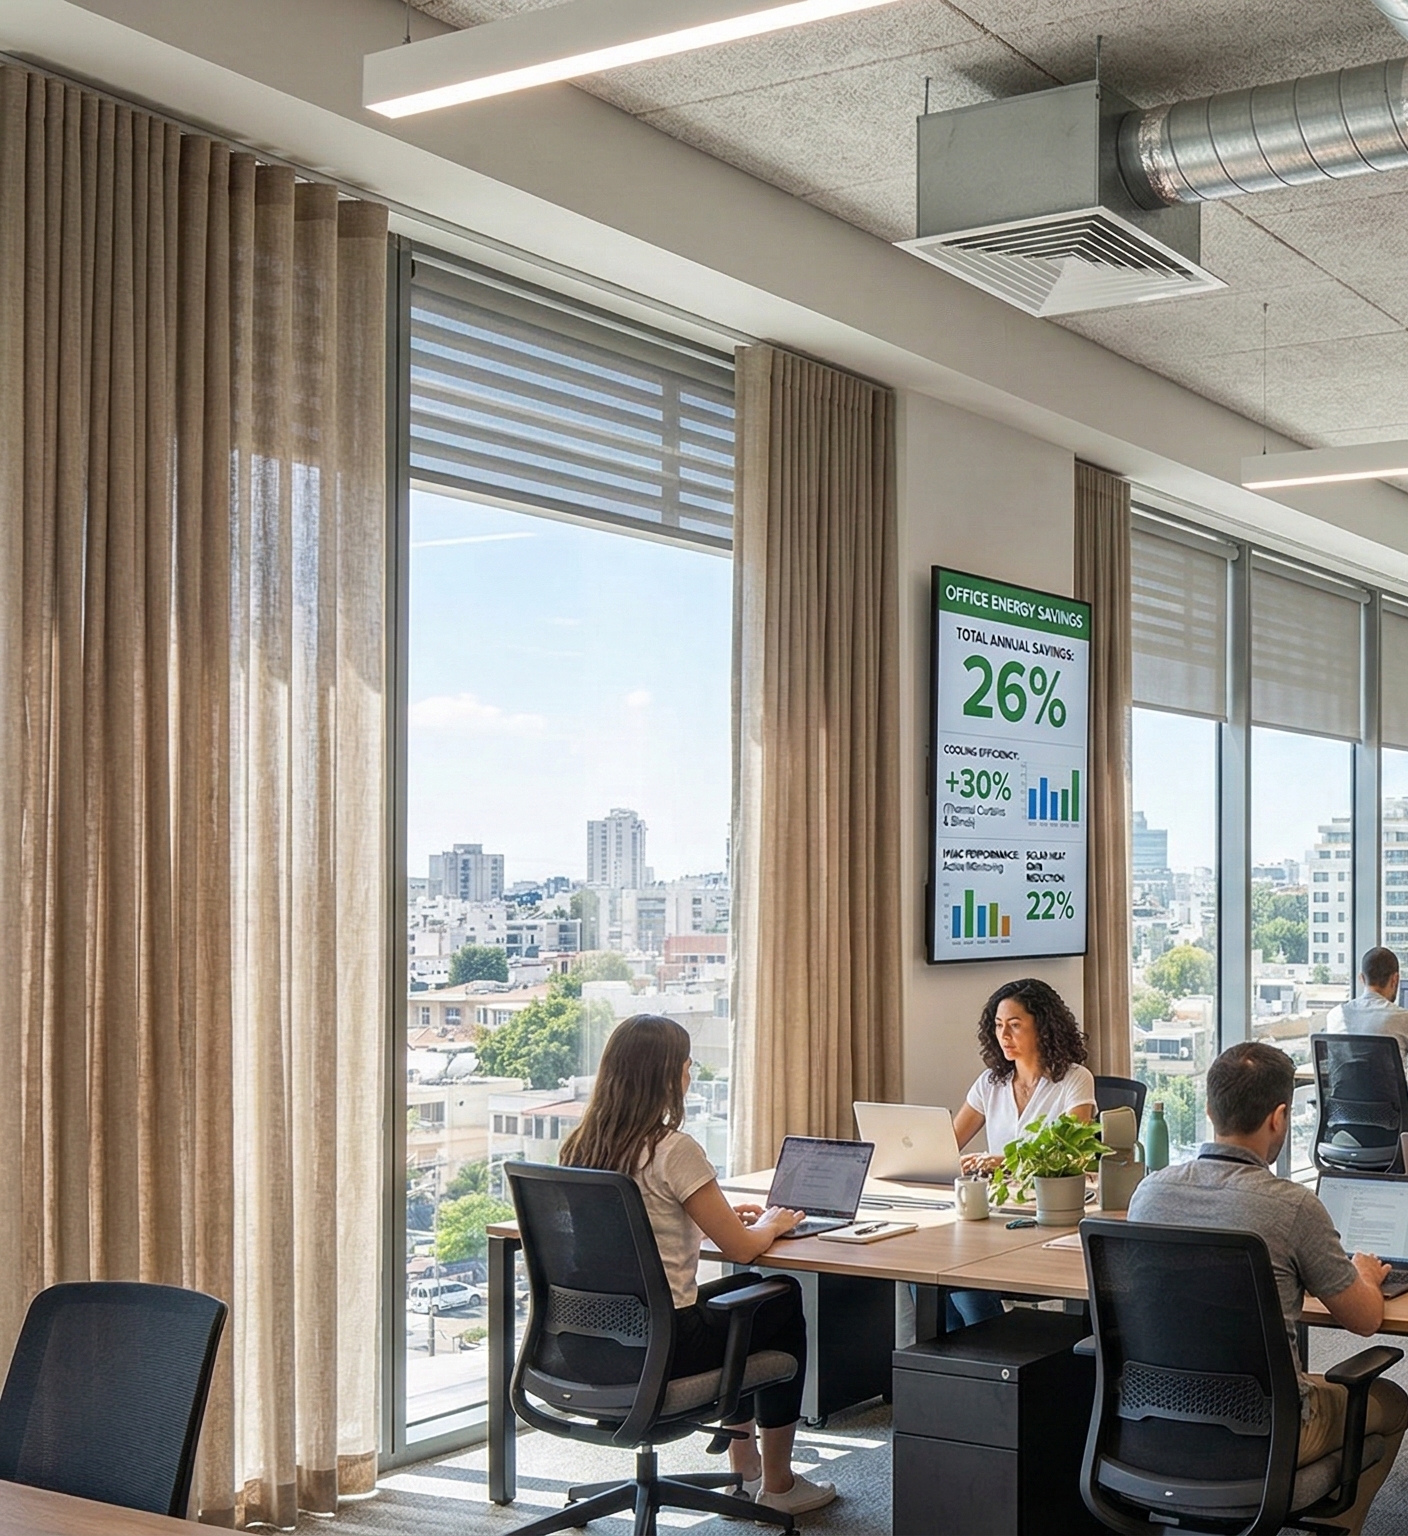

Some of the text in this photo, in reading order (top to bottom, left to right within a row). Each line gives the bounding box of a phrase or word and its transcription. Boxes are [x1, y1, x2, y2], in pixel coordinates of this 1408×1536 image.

[945, 584, 1083, 629] OFFICE ENERGY SAVINGS
[956, 626, 988, 645] TOTAL
[990, 634, 1030, 653] ANNUAL
[963, 654, 1066, 728] 26%
[945, 768, 1012, 801] +30%
[1026, 890, 1075, 920] 22%
